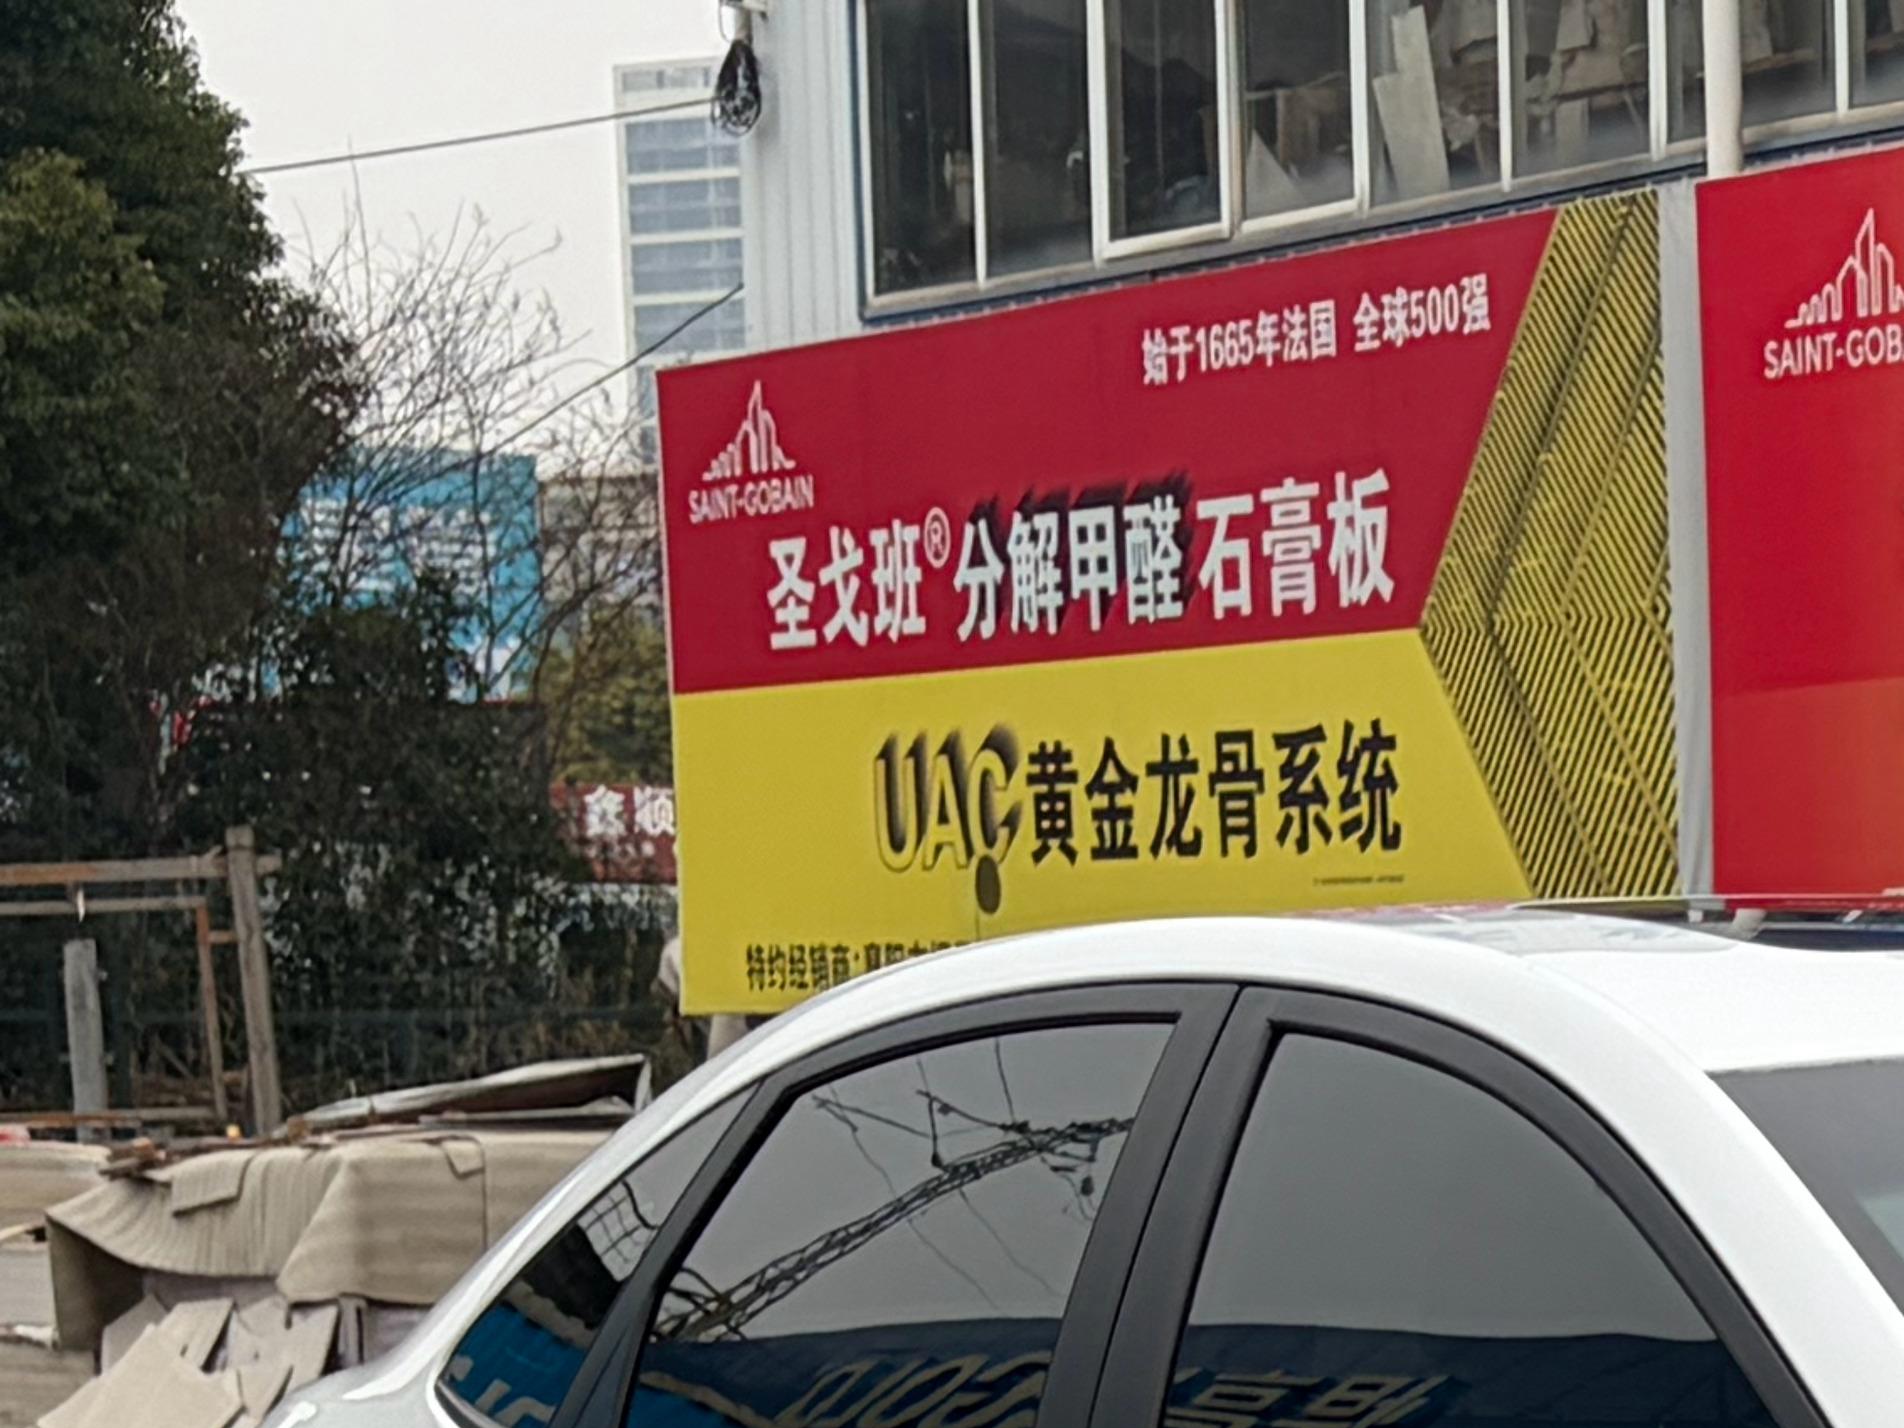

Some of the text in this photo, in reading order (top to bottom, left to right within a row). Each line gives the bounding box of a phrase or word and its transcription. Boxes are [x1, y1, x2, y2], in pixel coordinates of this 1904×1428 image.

[1141, 272, 1493, 386] 始于1665年法国 全球500强
[687, 473, 816, 526] SAINT-GOBAIN
